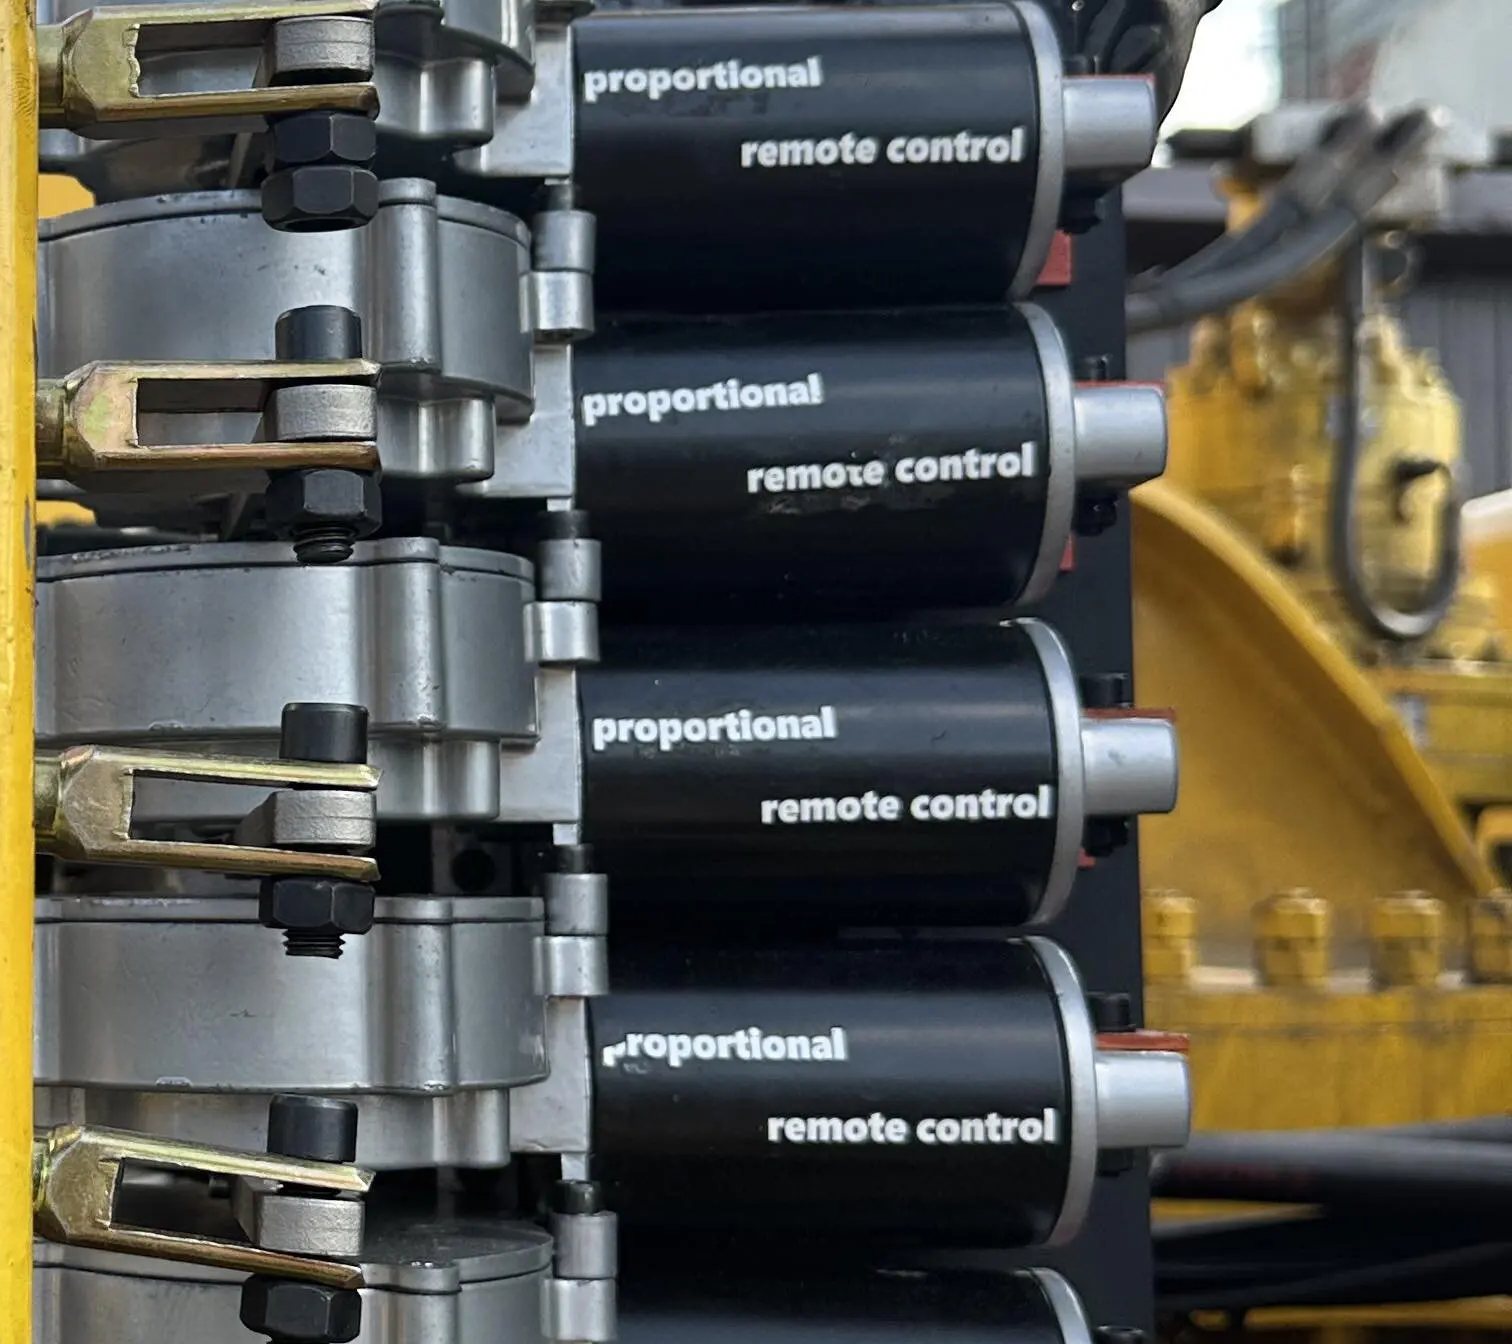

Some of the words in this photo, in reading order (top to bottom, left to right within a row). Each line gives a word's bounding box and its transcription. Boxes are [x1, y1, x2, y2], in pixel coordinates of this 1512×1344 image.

[584, 56, 823, 103] proportional
[741, 133, 877, 167] remote
[886, 127, 1024, 163] control
[582, 373, 824, 426] proportional
[747, 459, 885, 493] remote
[895, 442, 1034, 484] control
[592, 705, 838, 751] proportional
[761, 790, 901, 824] remote
[910, 784, 1051, 820] control
[767, 1111, 908, 1144] remote
[916, 1107, 1057, 1144] control
